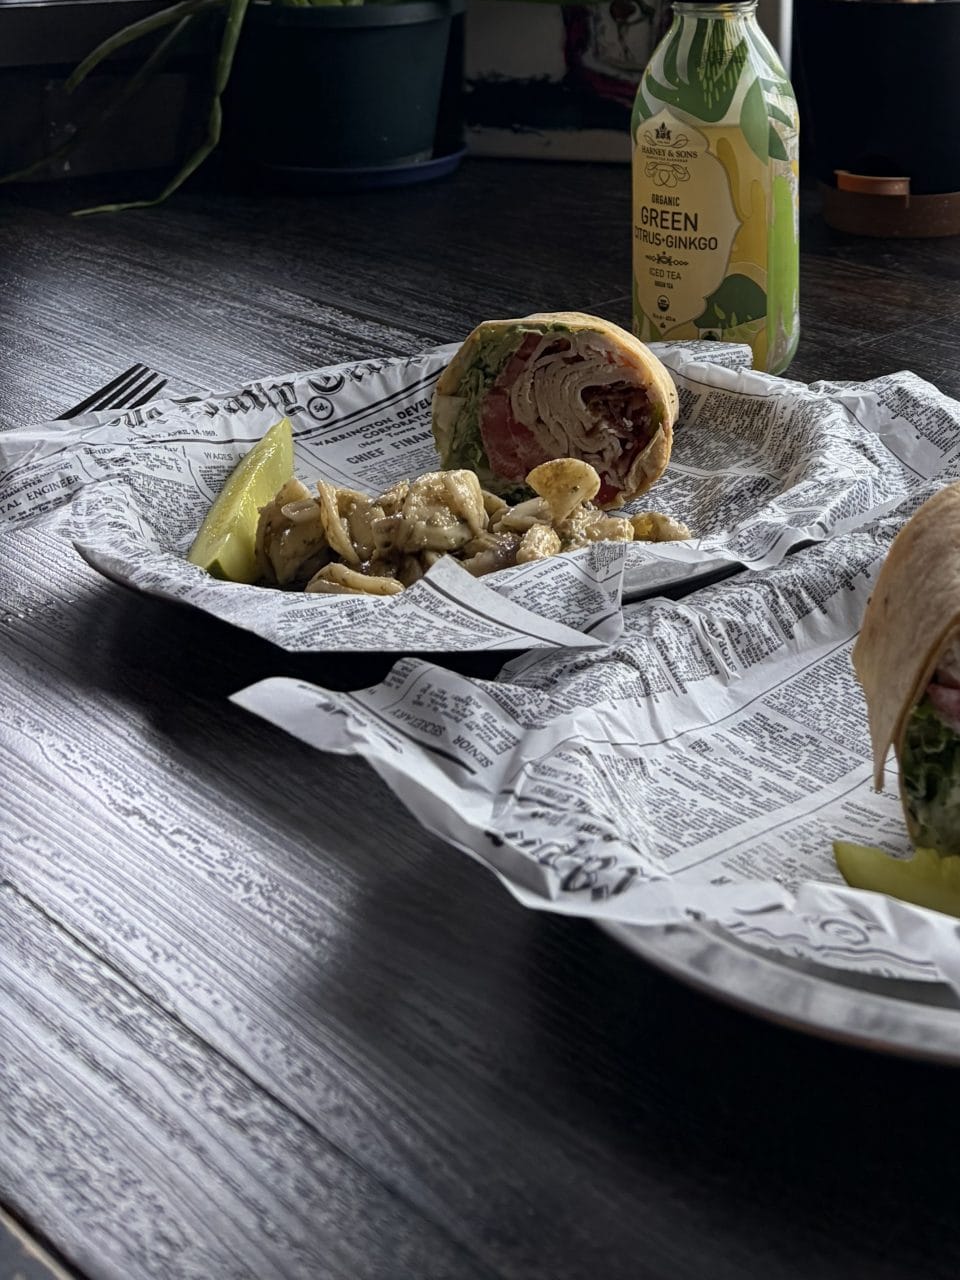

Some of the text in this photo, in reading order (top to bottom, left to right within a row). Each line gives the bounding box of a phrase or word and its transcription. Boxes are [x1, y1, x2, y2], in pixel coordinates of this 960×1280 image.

[642, 145, 699, 159] HARNEY & SONS
[652, 193, 680, 206] ORGANIC
[641, 206, 699, 232] GREEN
[649, 267, 682, 281] ICED TEA
[166, 428, 190, 437] APRIL
[308, 395, 434, 450] WARRINGTON DEVEL
[361, 409, 433, 441] CORPORATIO
[203, 451, 234, 460] WAGES
[345, 428, 435, 465] CHIEF FINAN
[26, 474, 81, 501] ENGINEER
[390, 707, 447, 737] SECRETARY
[451, 733, 493, 770] SENIOR
